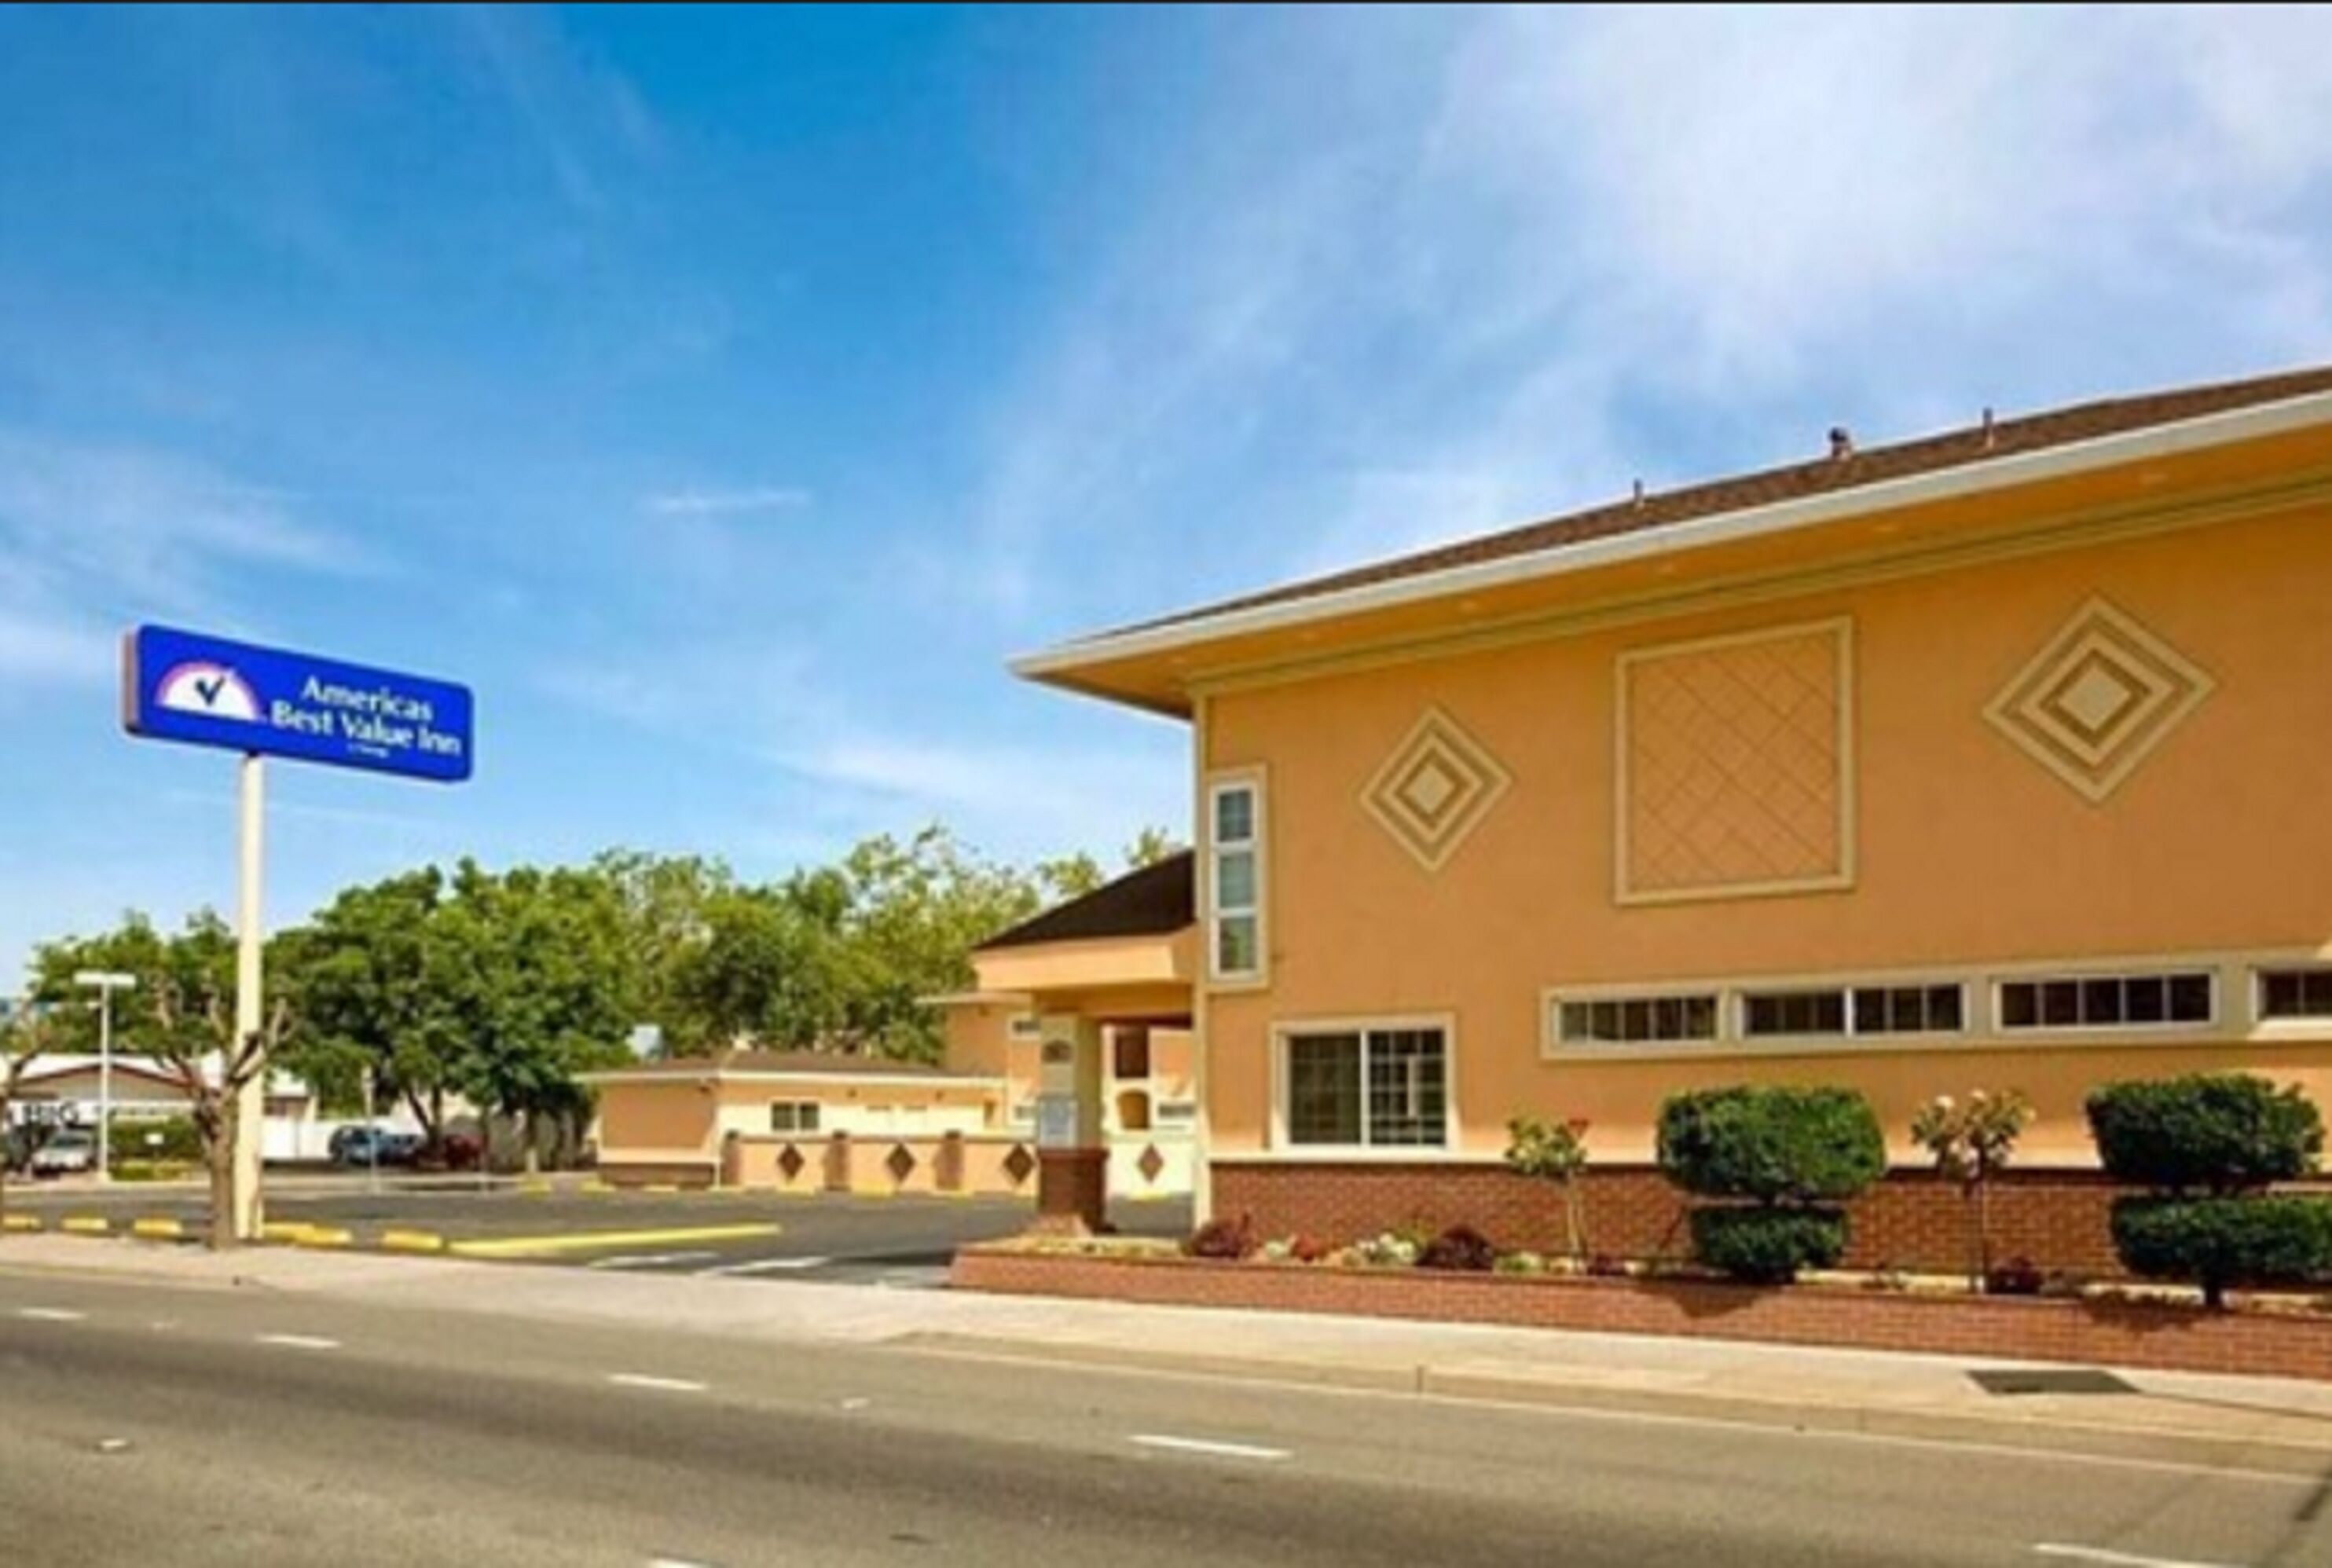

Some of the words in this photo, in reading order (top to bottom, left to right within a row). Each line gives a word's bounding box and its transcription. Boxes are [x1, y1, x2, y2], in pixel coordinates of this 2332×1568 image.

[302, 676, 432, 721] Americas
[271, 701, 332, 735] Best
[341, 714, 414, 748] Value
[418, 727, 462, 757] Inn
